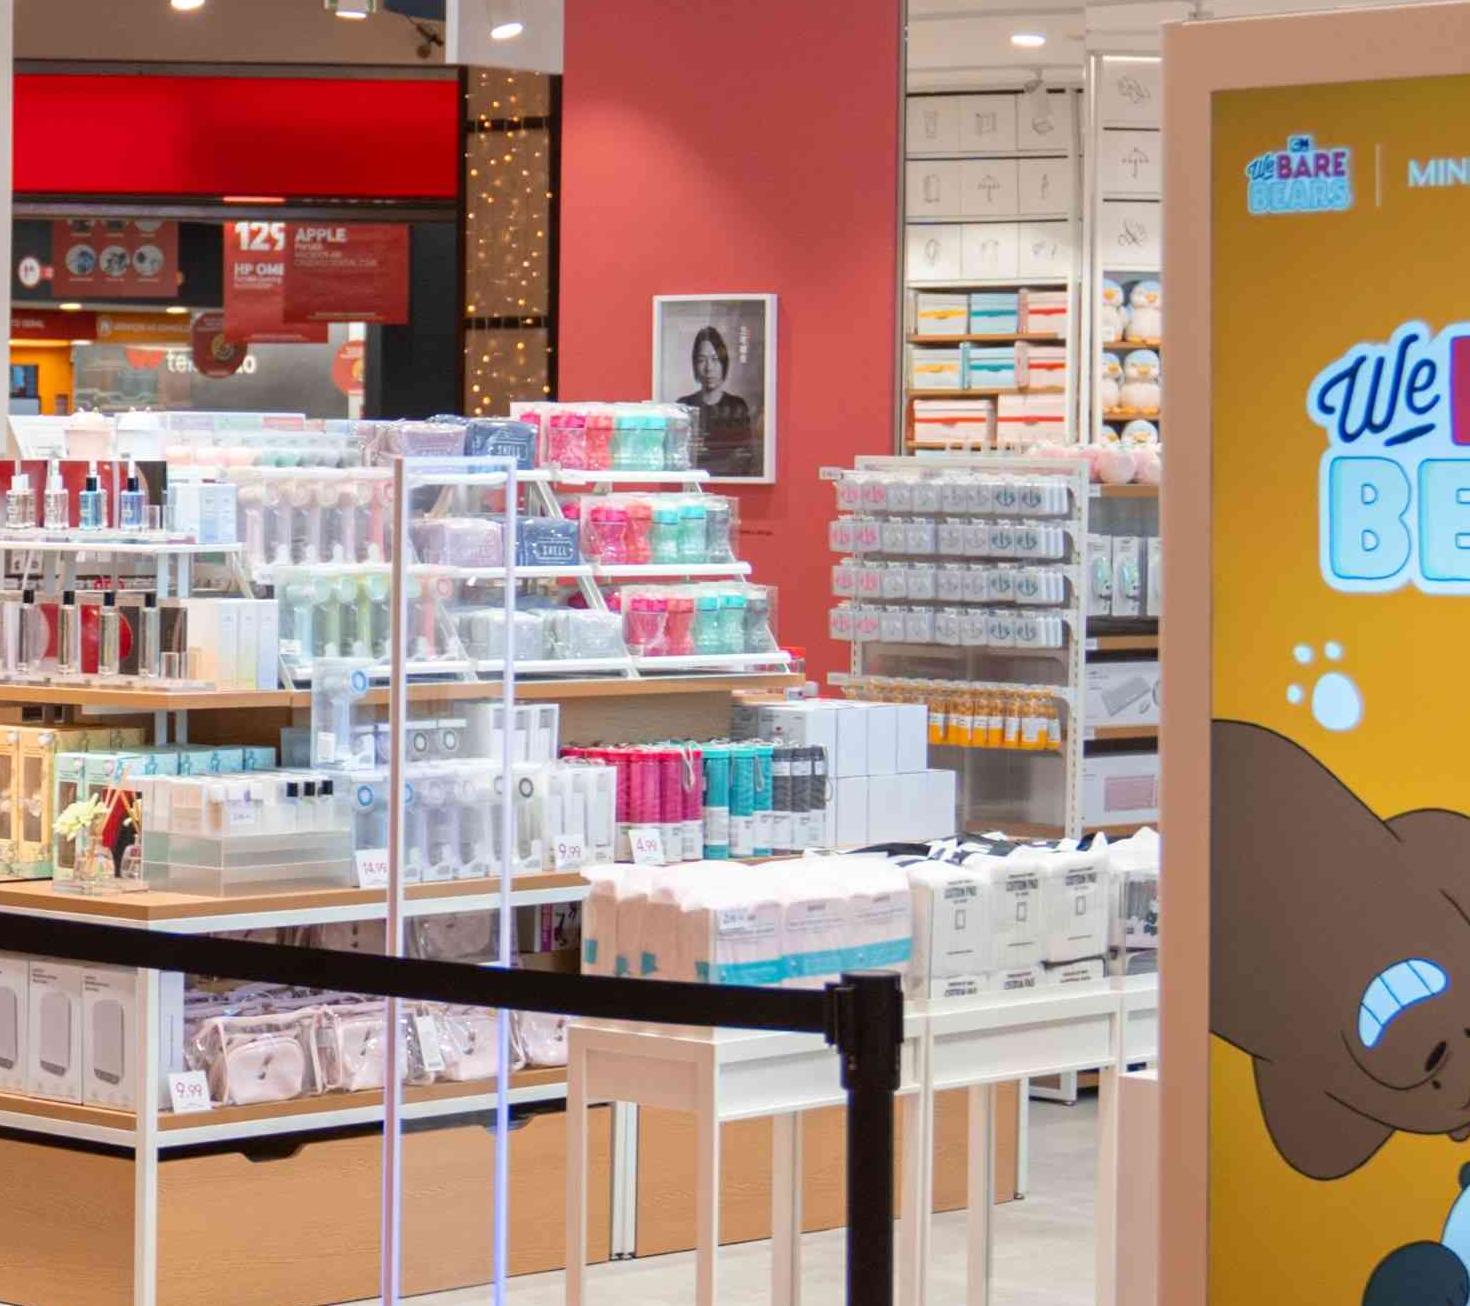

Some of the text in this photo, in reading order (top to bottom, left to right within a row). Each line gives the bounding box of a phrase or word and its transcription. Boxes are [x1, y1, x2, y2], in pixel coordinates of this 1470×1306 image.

[1246, 151, 1347, 181] We BARE
[1249, 180, 1350, 211] BEARS
[294, 228, 347, 243] APPLE
[256, 262, 285, 276] OME
[1316, 332, 1442, 447] We
[175, 1081, 202, 1099] 9.99
